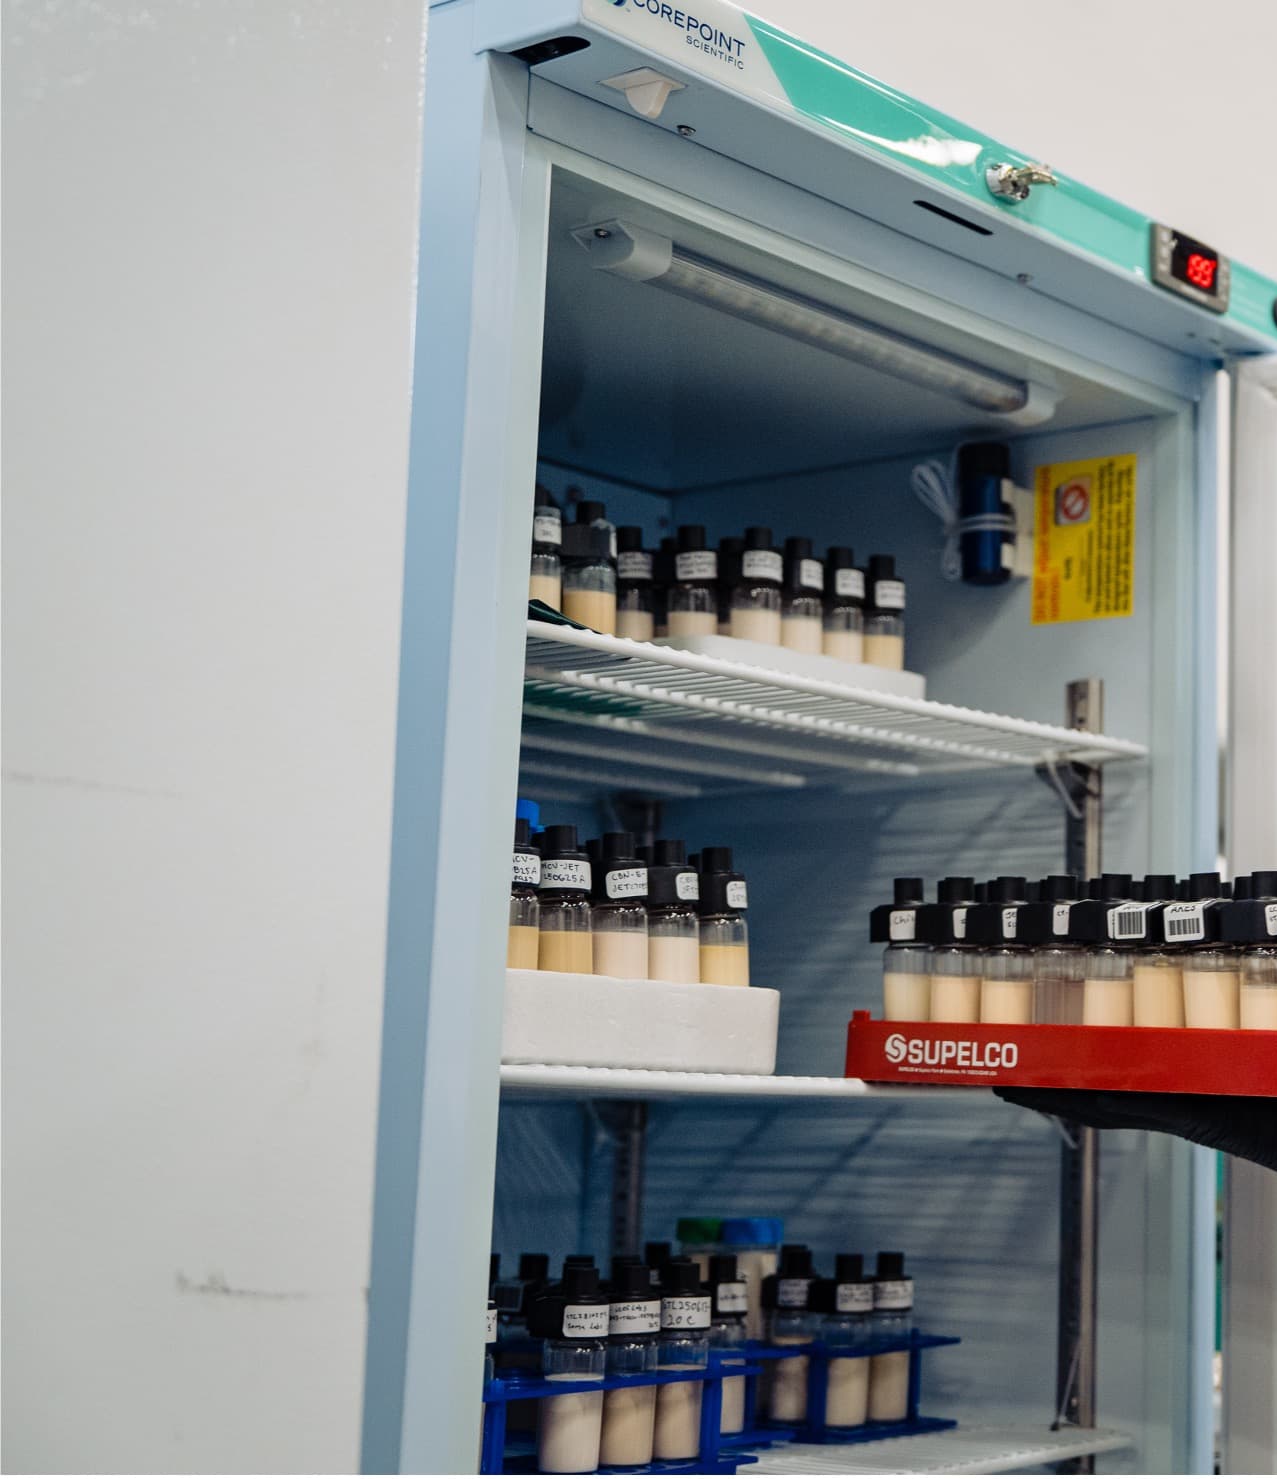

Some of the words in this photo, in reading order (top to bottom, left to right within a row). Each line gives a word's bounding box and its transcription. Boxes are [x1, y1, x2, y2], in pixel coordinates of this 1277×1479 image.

[633, 0, 746, 57] COREPOINT
[686, 35, 745, 70] SCIENTIFIC
[907, 1038, 1018, 1069] SUPELCO
